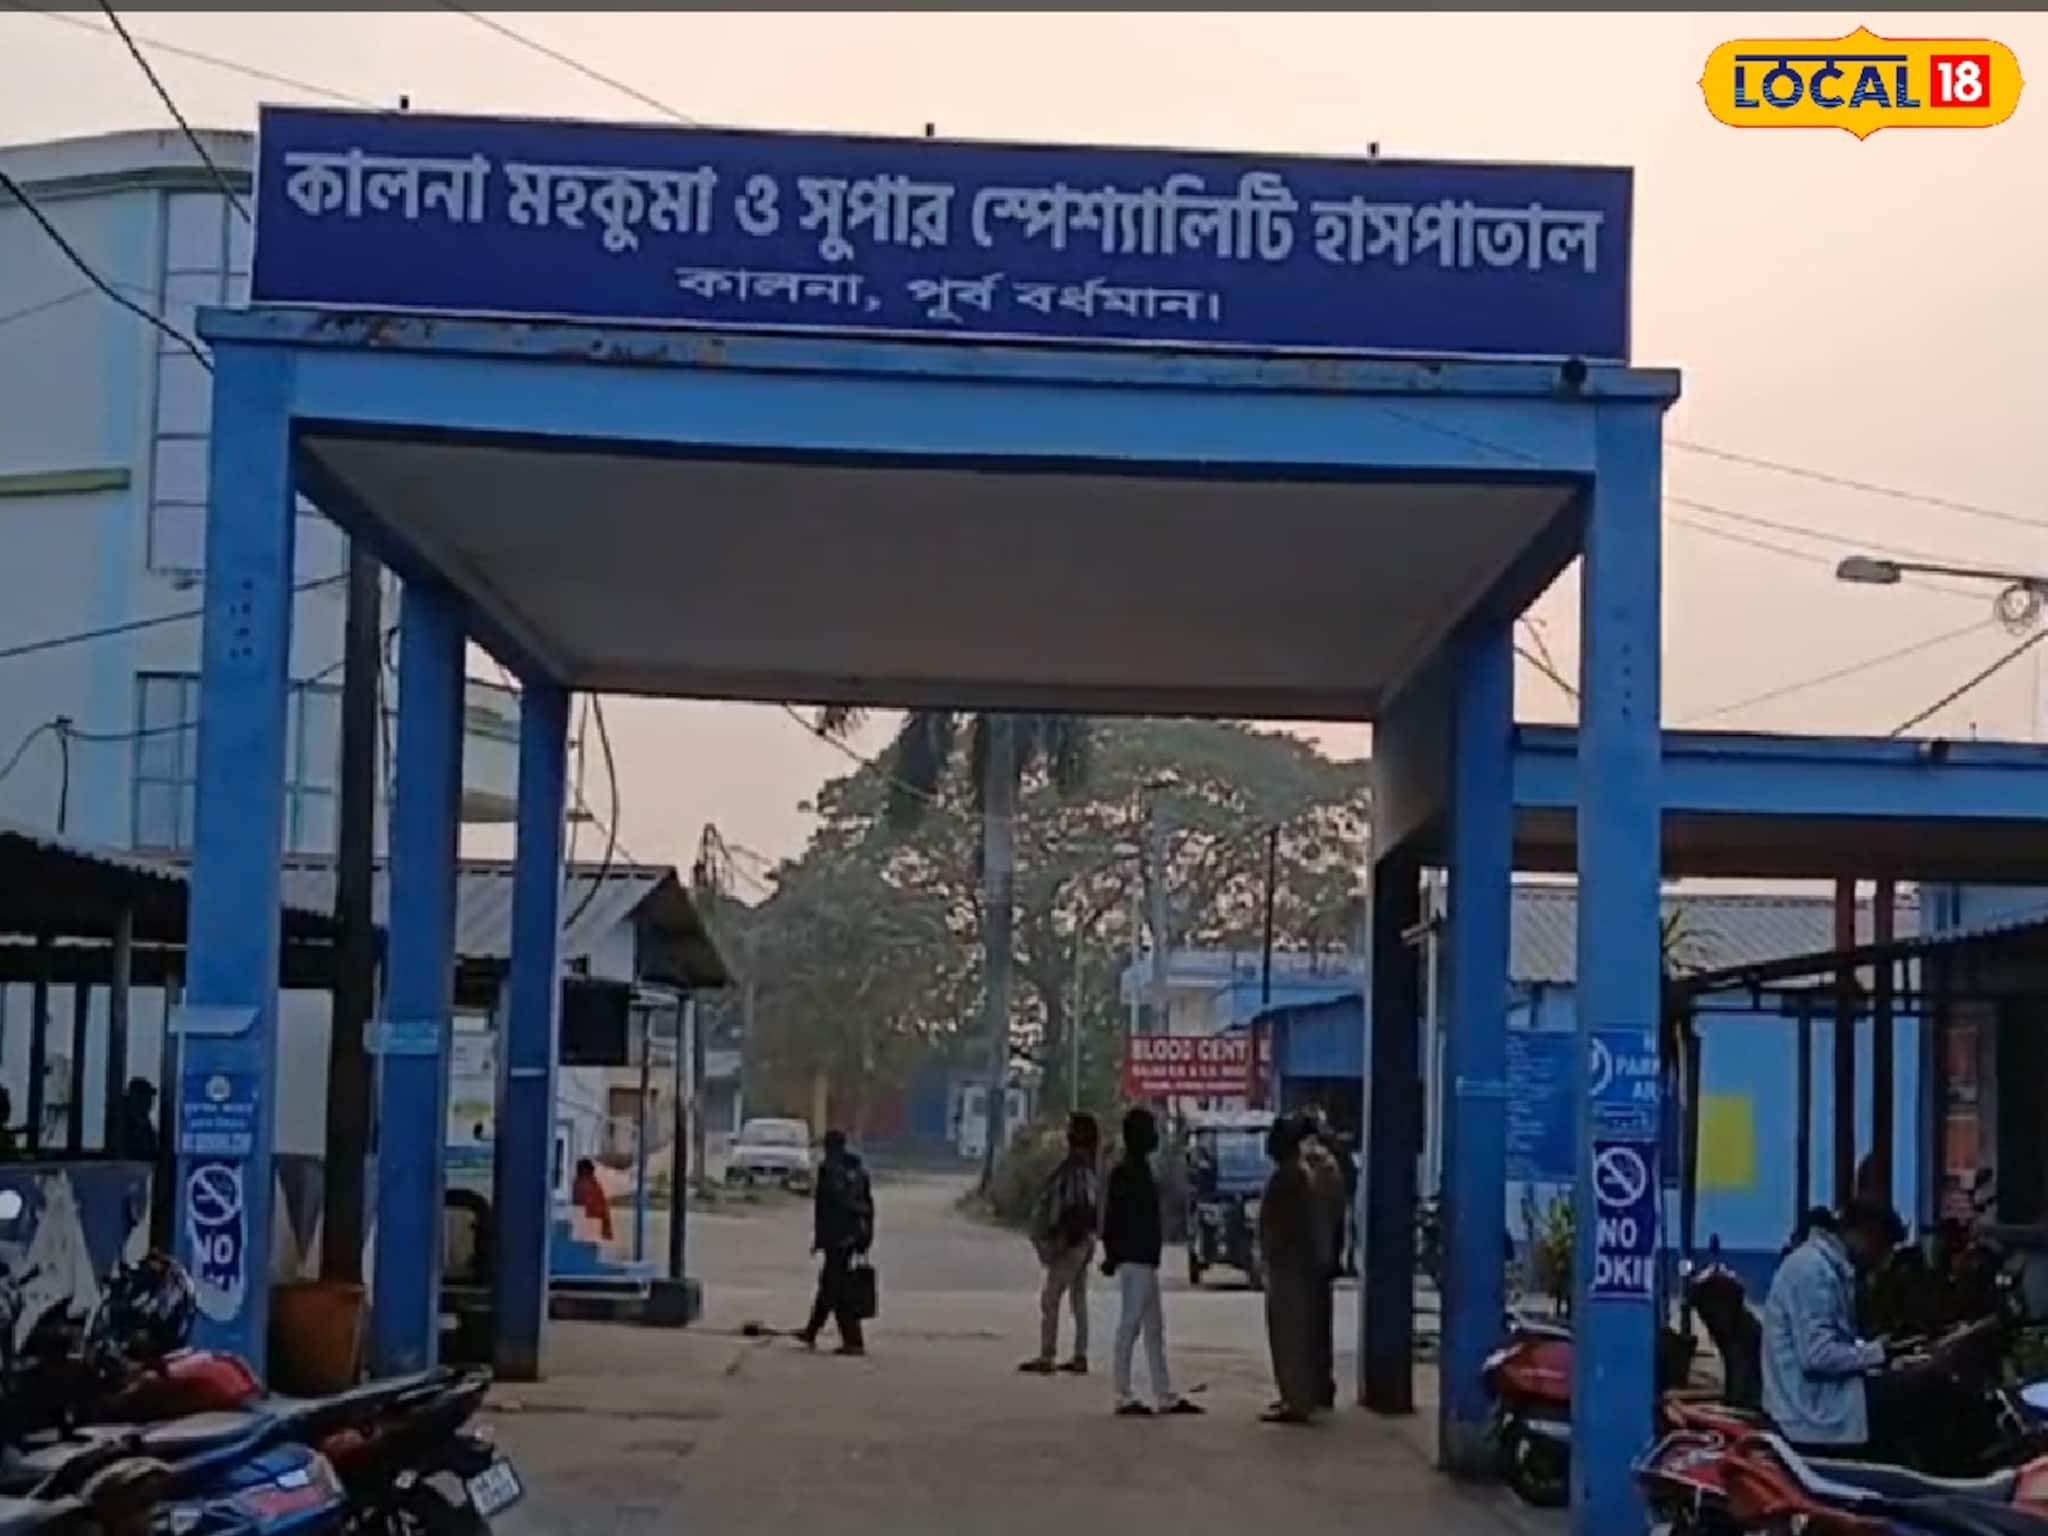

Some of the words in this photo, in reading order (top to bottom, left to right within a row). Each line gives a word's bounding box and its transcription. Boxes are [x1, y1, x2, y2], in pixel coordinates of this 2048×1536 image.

[284, 149, 491, 220] কালনা
[505, 163, 718, 251] মহকুমা
[734, 175, 779, 234] ও
[798, 174, 956, 262] সুপার
[971, 171, 1299, 260] স্পেশ্যালিটি
[1310, 195, 1604, 271] হাসপাতাল
[674, 266, 882, 313] কালনা,
[1597, 1217, 1638, 1249] NO
